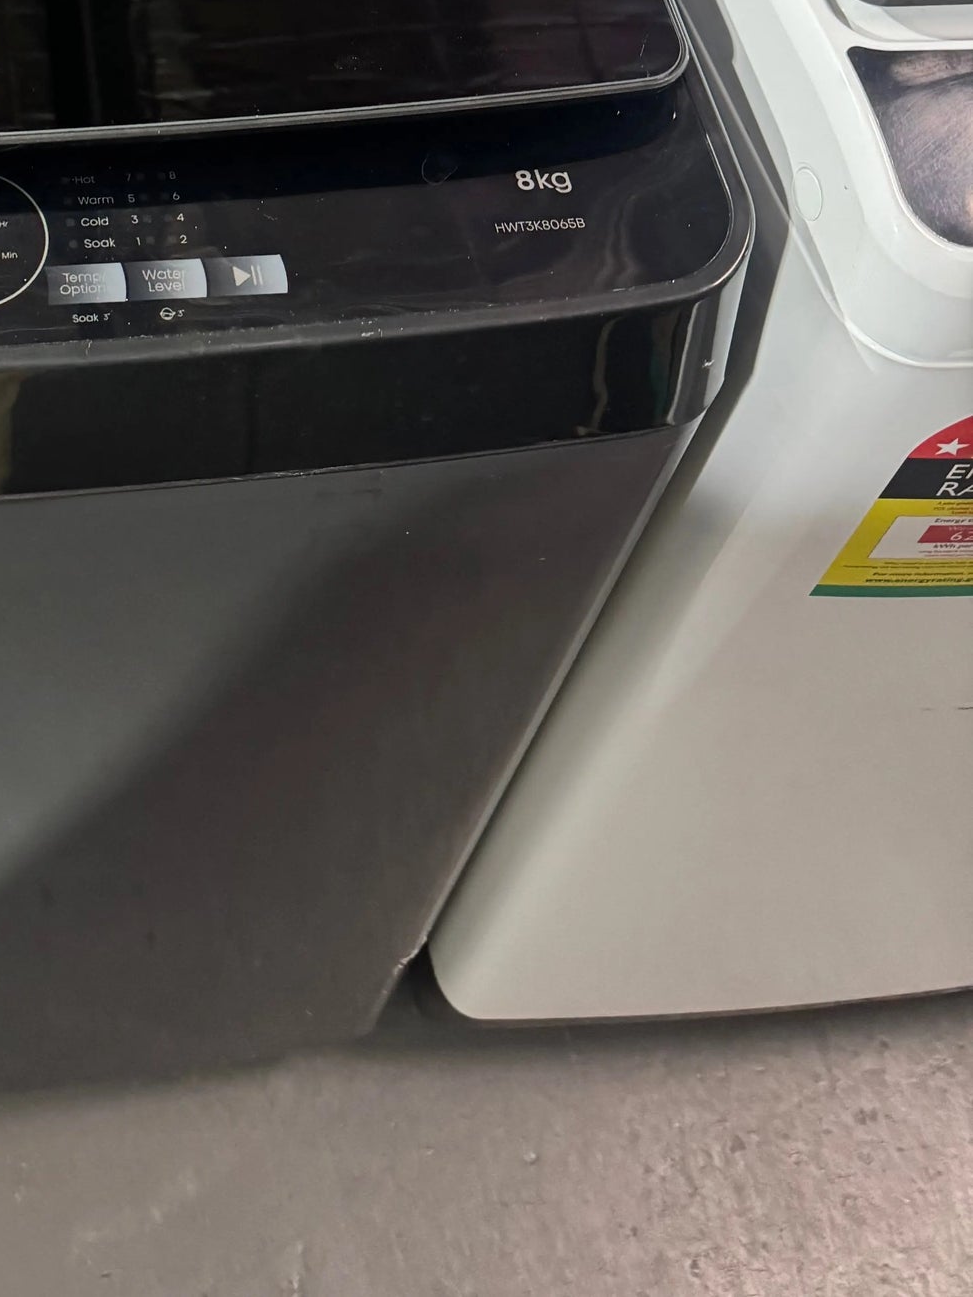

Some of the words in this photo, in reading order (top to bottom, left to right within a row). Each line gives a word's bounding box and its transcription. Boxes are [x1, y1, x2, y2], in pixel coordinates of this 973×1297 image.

[74, 175, 96, 184] Hot
[169, 171, 176, 180] 8
[515, 168, 573, 194] 8kg
[77, 196, 115, 205] Warm
[127, 193, 135, 203] 5
[172, 191, 180, 201] 6
[80, 216, 109, 227] Cold
[130, 214, 139, 224] 3
[176, 212, 185, 222] 4
[494, 217, 586, 234] HWT3K8065B
[83, 237, 116, 249] Soak
[179, 234, 187, 244] 2
[1, 251, 18, 260] Min
[141, 268, 187, 281] Water
[148, 279, 186, 292] Level
[72, 313, 99, 324] Soak
